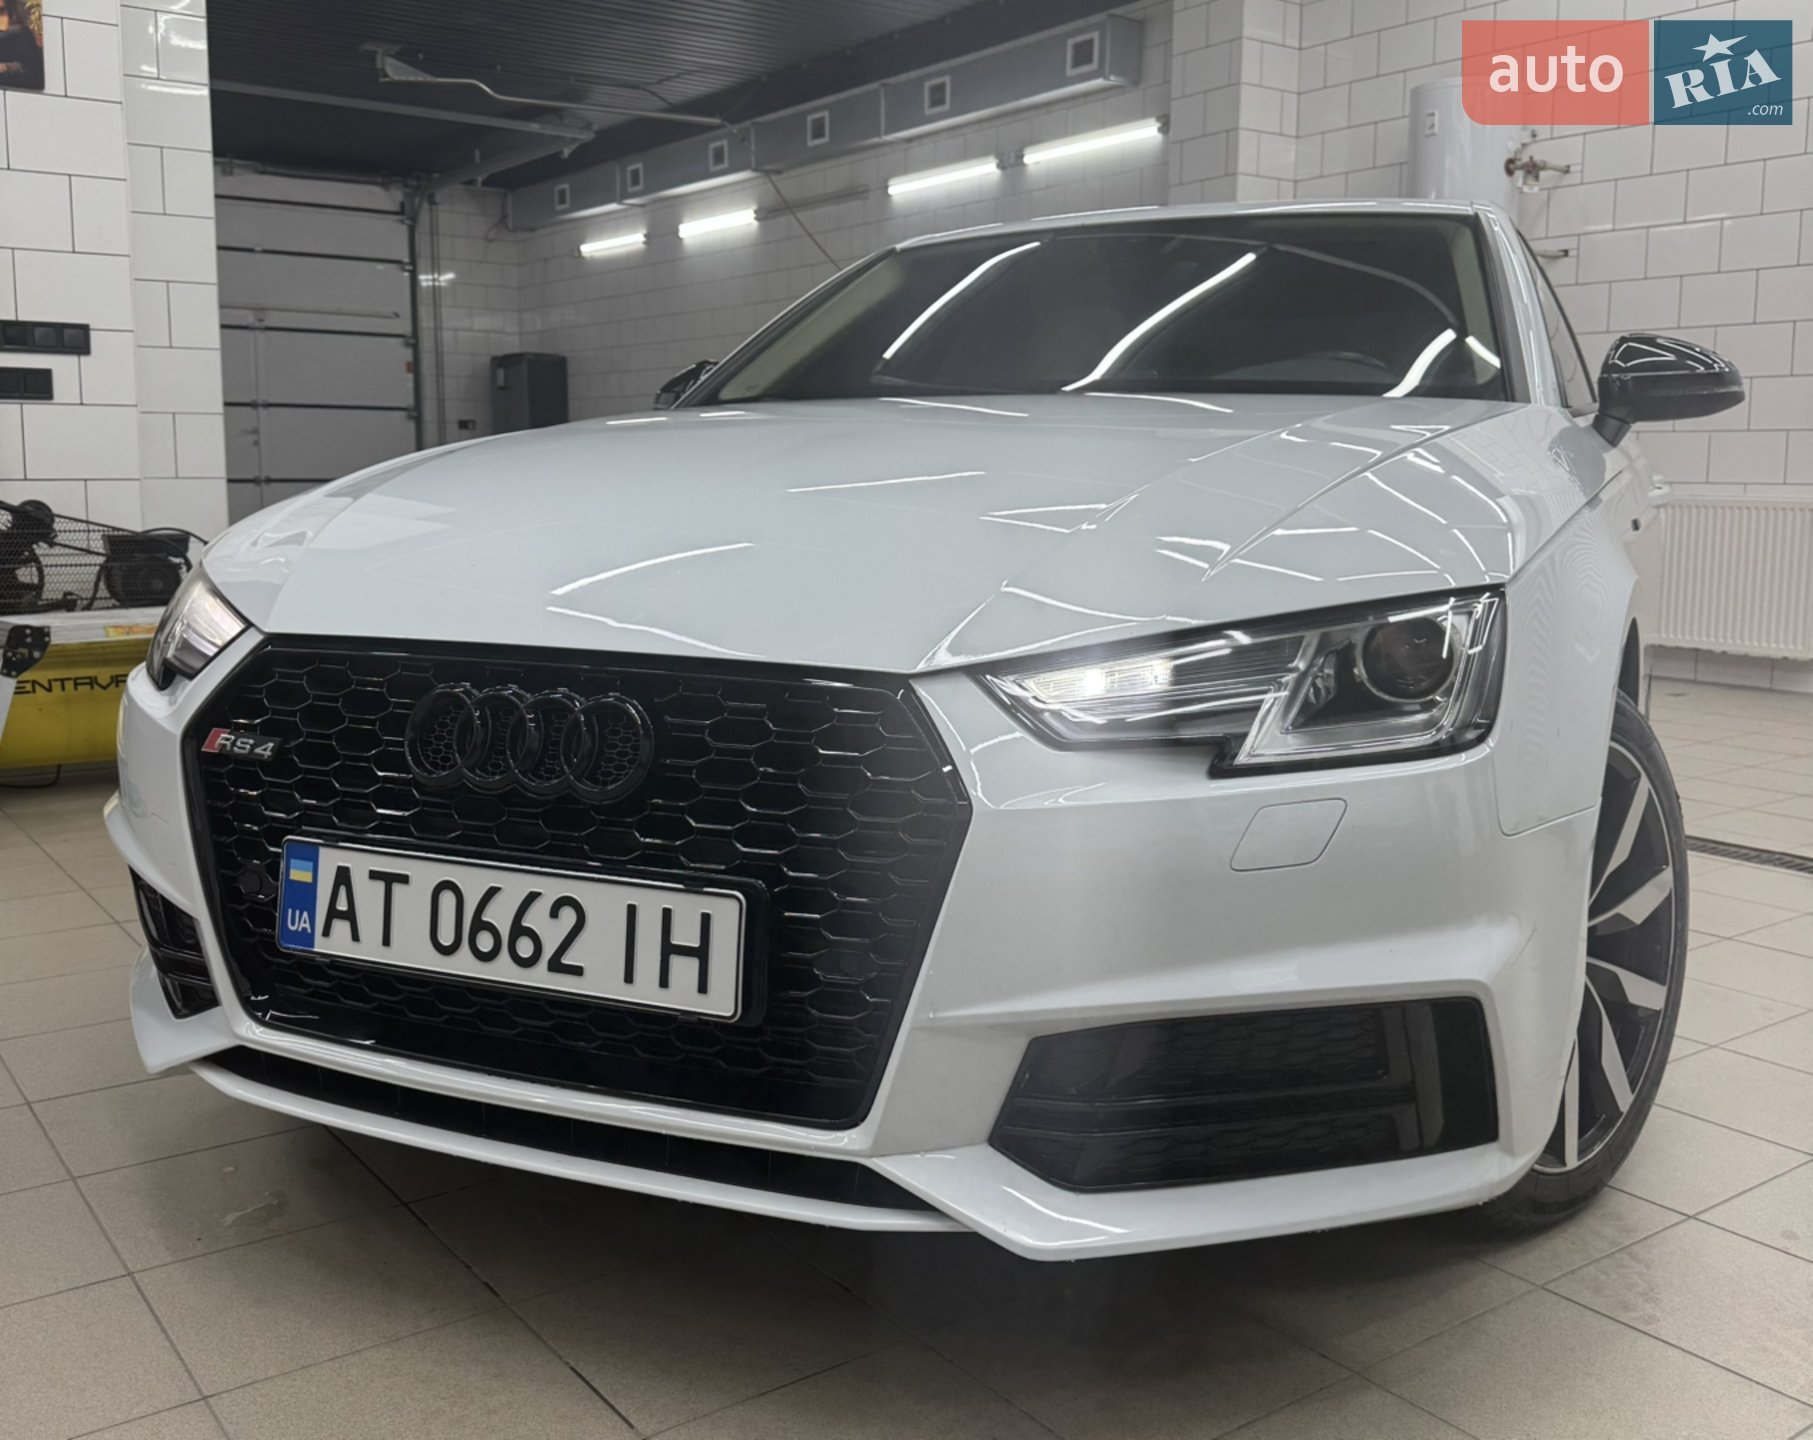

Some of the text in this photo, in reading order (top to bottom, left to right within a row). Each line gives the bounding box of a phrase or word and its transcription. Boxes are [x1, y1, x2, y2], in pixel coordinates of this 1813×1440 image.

[214, 733, 275, 760] RS4
[287, 908, 312, 934] UA
[321, 863, 713, 995] AT 0662 IH
